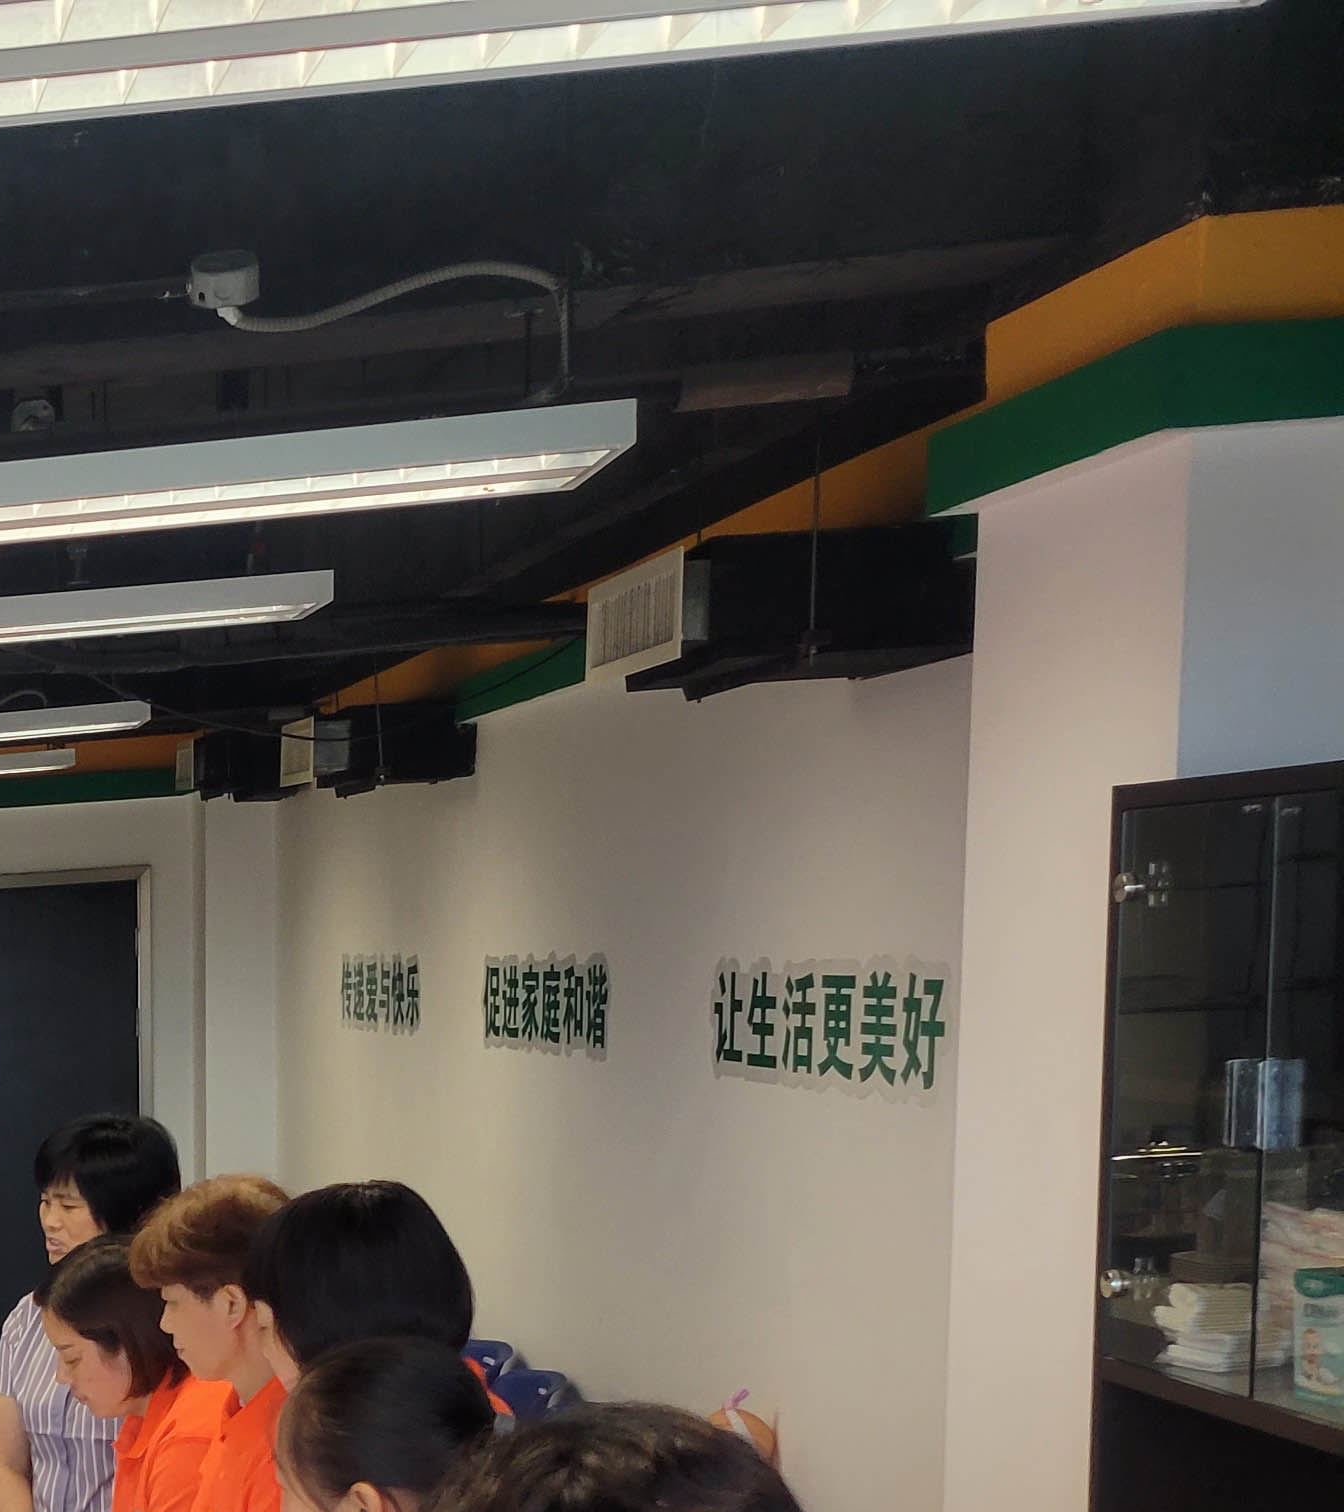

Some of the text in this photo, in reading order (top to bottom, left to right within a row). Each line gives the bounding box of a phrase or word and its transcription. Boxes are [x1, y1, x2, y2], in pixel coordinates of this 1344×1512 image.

[341, 961, 418, 1027] 传递爱与快乐
[484, 964, 608, 1048] 促进家庭和谐
[714, 970, 946, 1090] 让生活更美好
